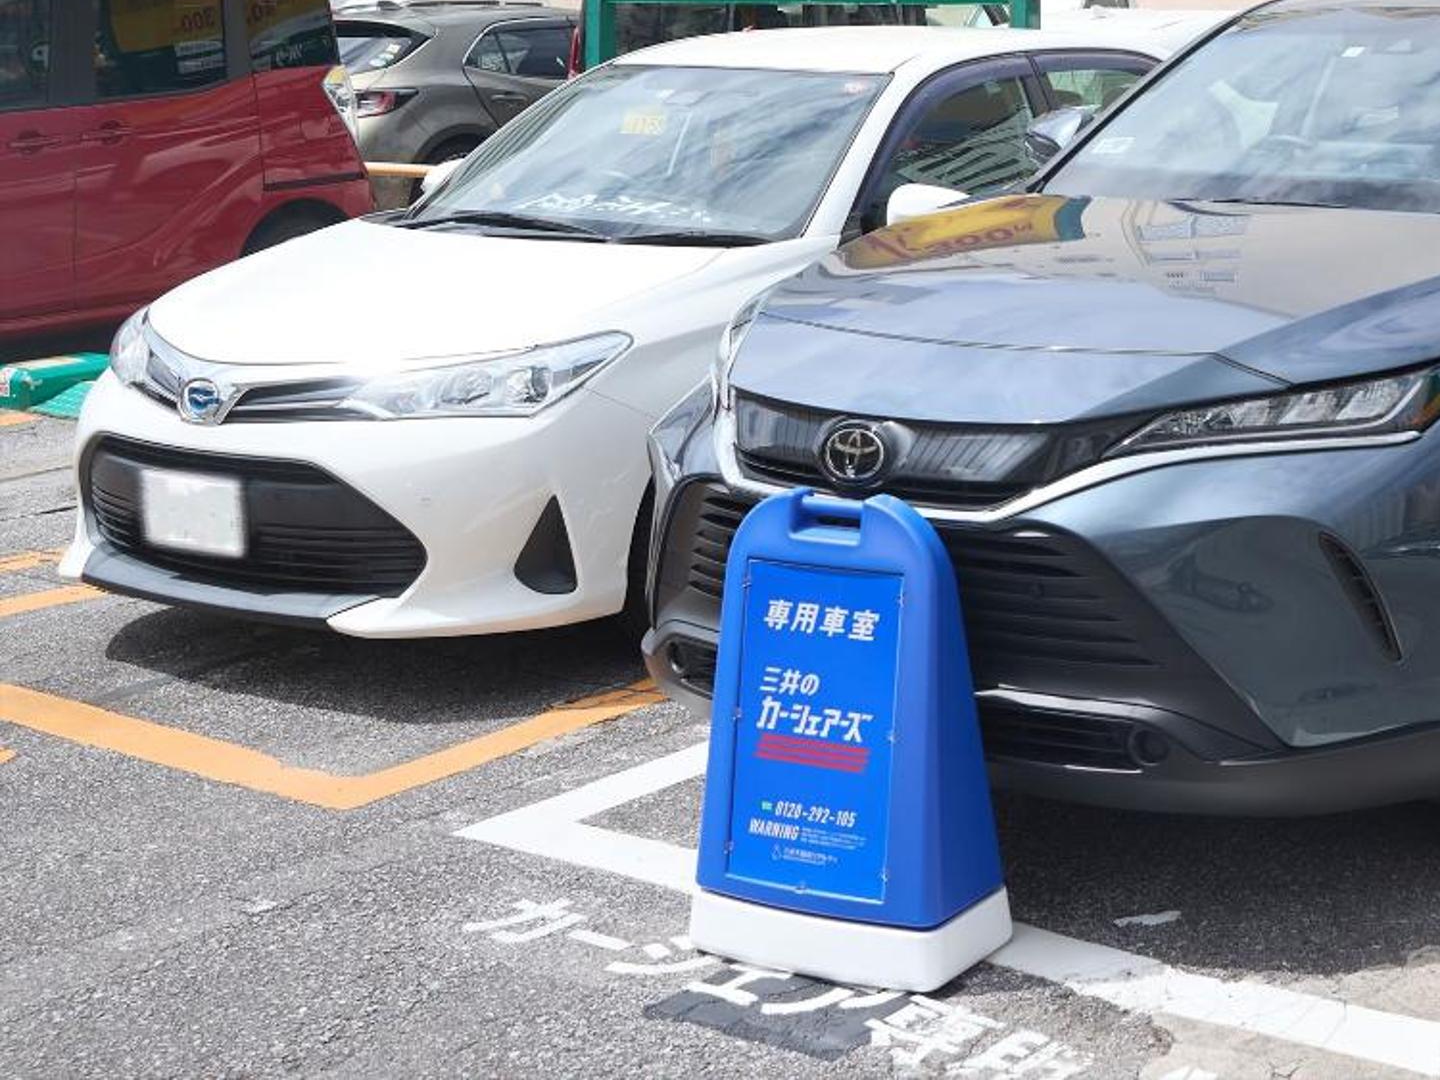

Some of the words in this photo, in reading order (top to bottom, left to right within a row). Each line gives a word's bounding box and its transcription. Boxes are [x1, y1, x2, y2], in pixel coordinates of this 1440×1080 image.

[763, 599, 880, 642] 専用車室
[759, 666, 820, 696] 三井の
[756, 695, 874, 744] カーシェアーズ
[775, 801, 857, 828] 0120-292-105
[749, 819, 800, 841] WARNING
